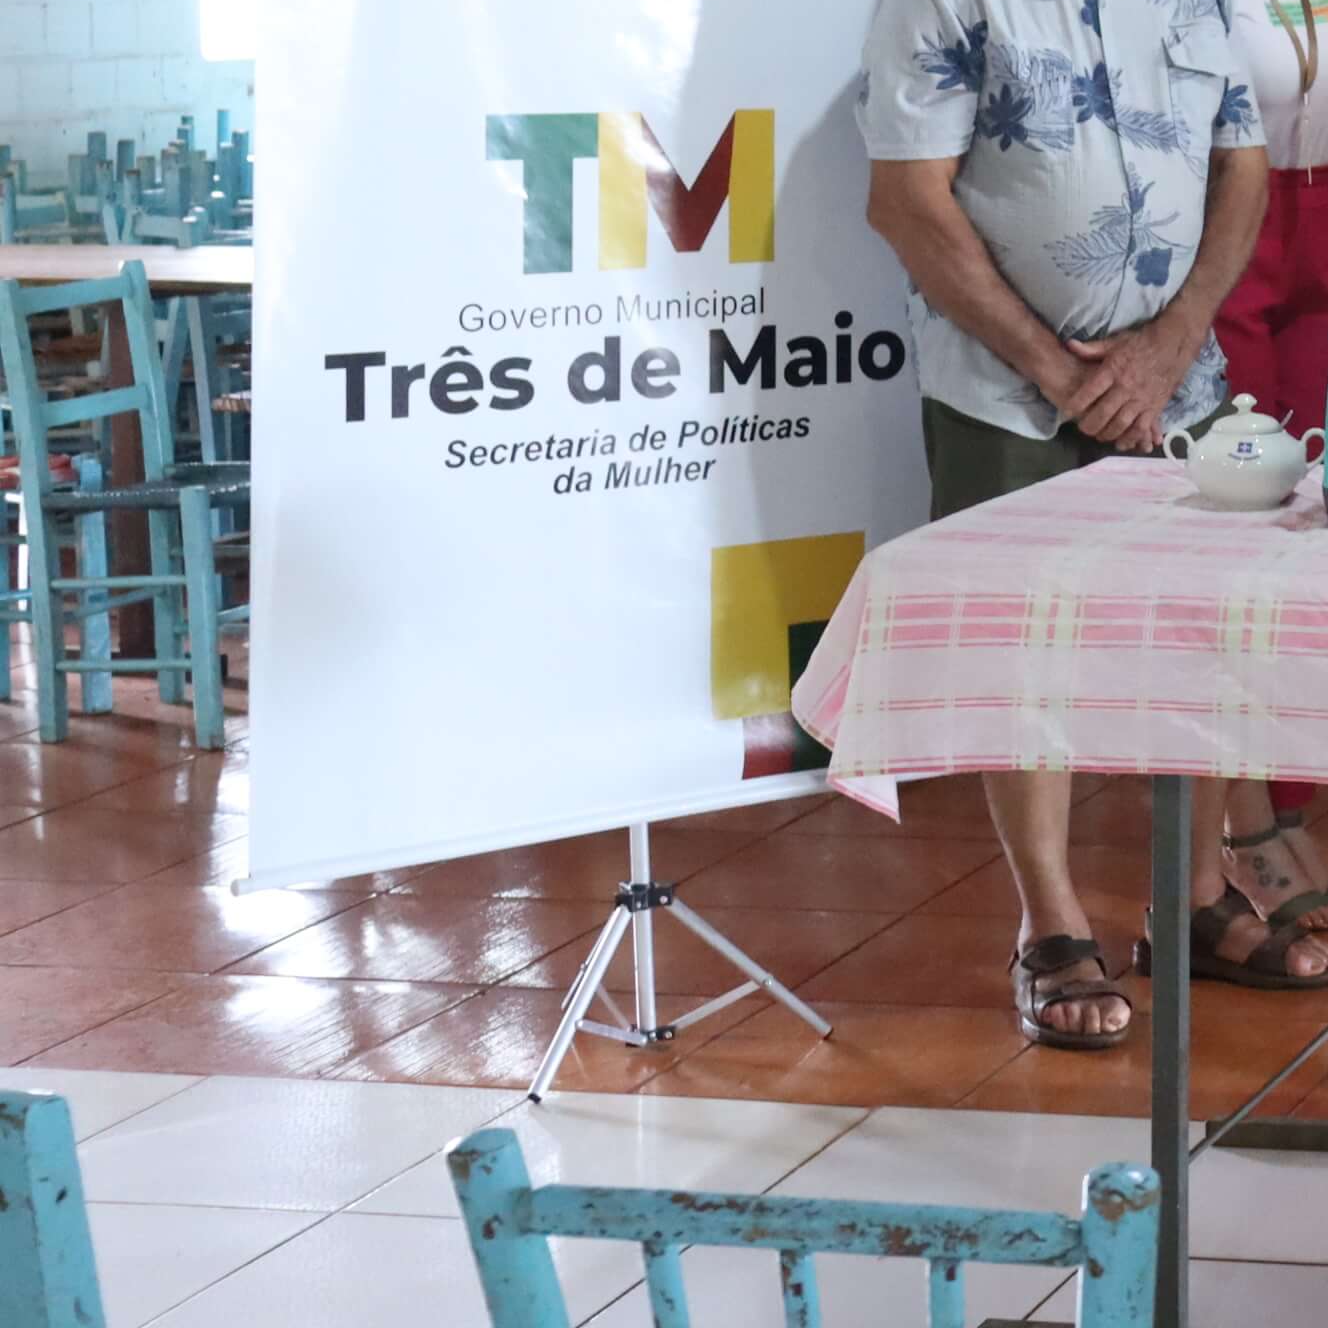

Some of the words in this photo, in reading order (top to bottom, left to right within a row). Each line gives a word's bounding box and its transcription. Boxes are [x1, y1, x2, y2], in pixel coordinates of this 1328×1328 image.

[487, 109, 775, 274] TM
[458, 301, 603, 333] Governo
[616, 288, 765, 323] Municipal
[324, 346, 535, 422] Três
[567, 336, 681, 405] de
[709, 311, 906, 394] Maio
[444, 429, 616, 469] Secretaria
[628, 425, 667, 454] de
[678, 414, 811, 448] Políticas
[553, 465, 593, 495] da
[604, 457, 716, 490] Mulher
